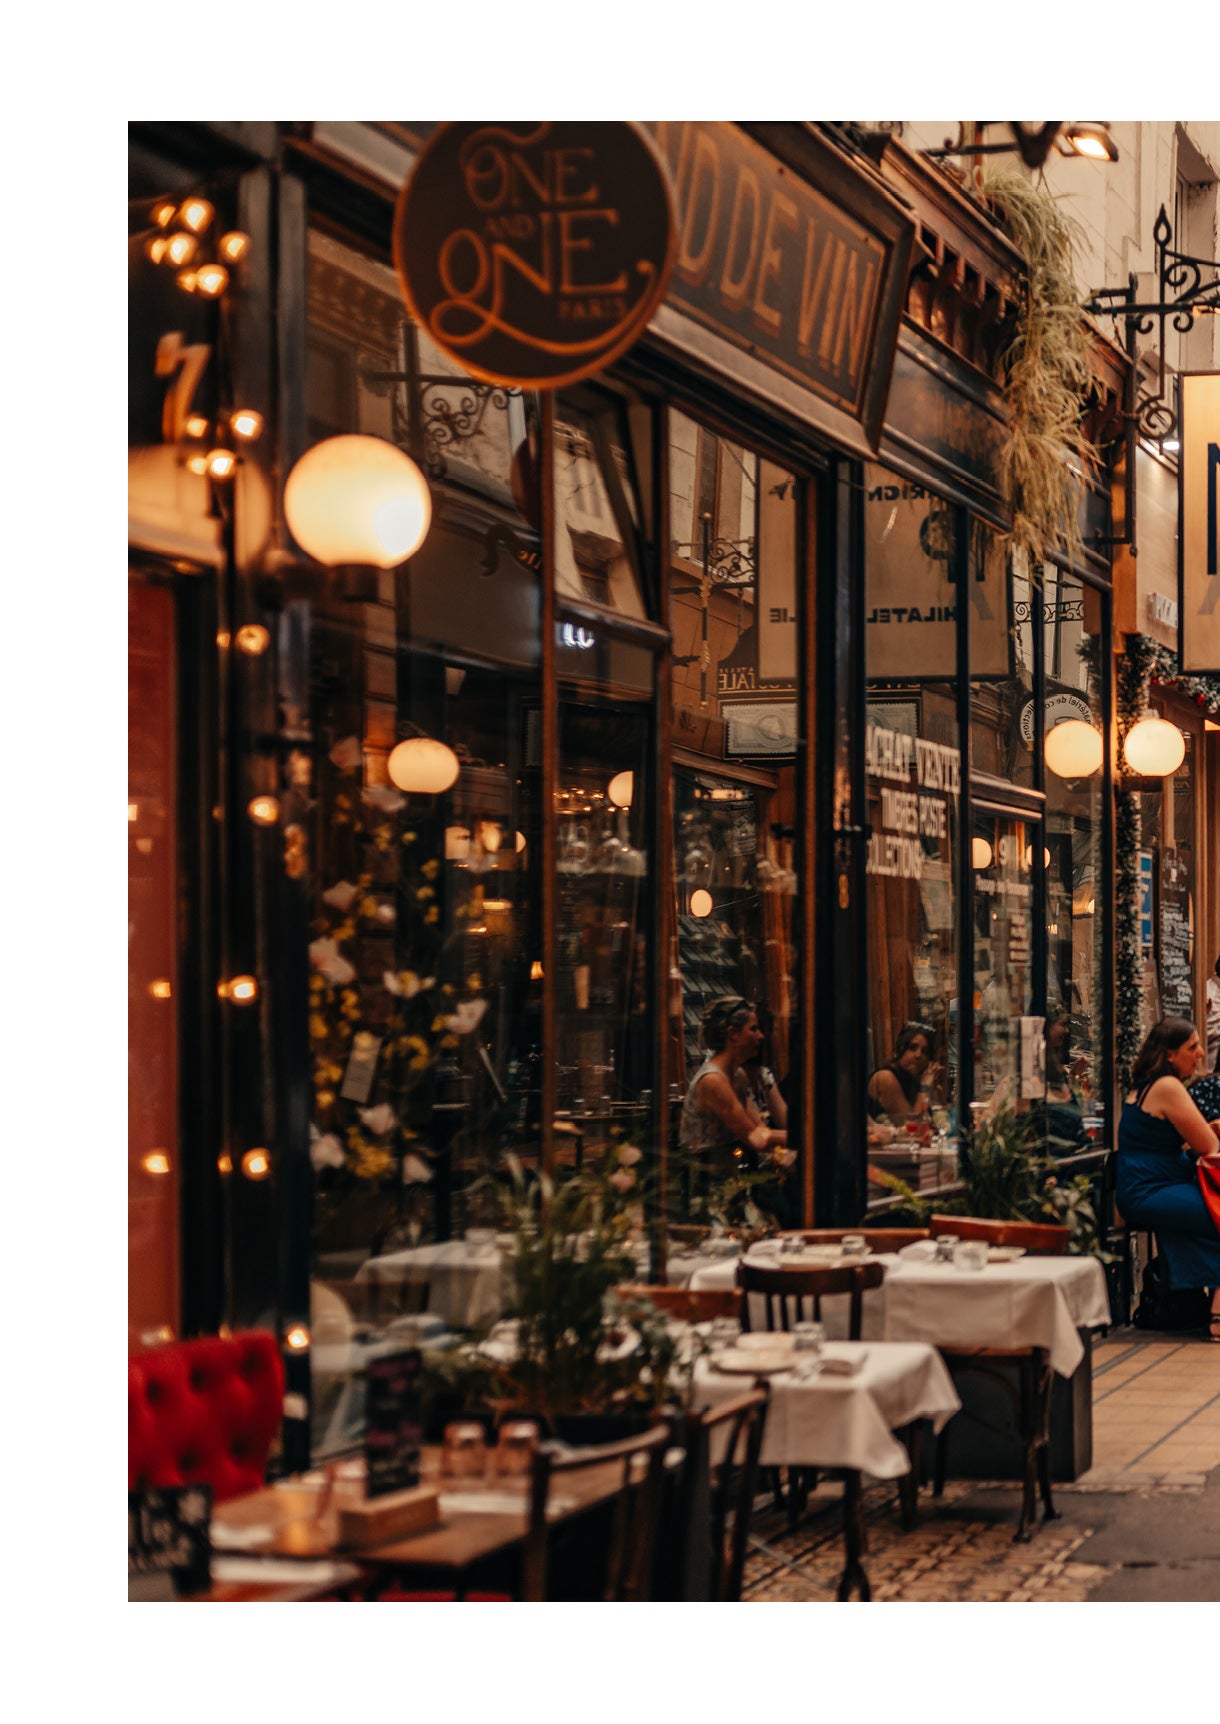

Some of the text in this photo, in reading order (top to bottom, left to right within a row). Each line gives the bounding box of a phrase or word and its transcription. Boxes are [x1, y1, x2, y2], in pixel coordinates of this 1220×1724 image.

[461, 126, 599, 208] ONE
[486, 214, 535, 238] AND
[431, 209, 650, 352] ONE
[559, 303, 627, 319] PARIS
[721, 164, 798, 337] DE
[797, 216, 875, 388] VIN
